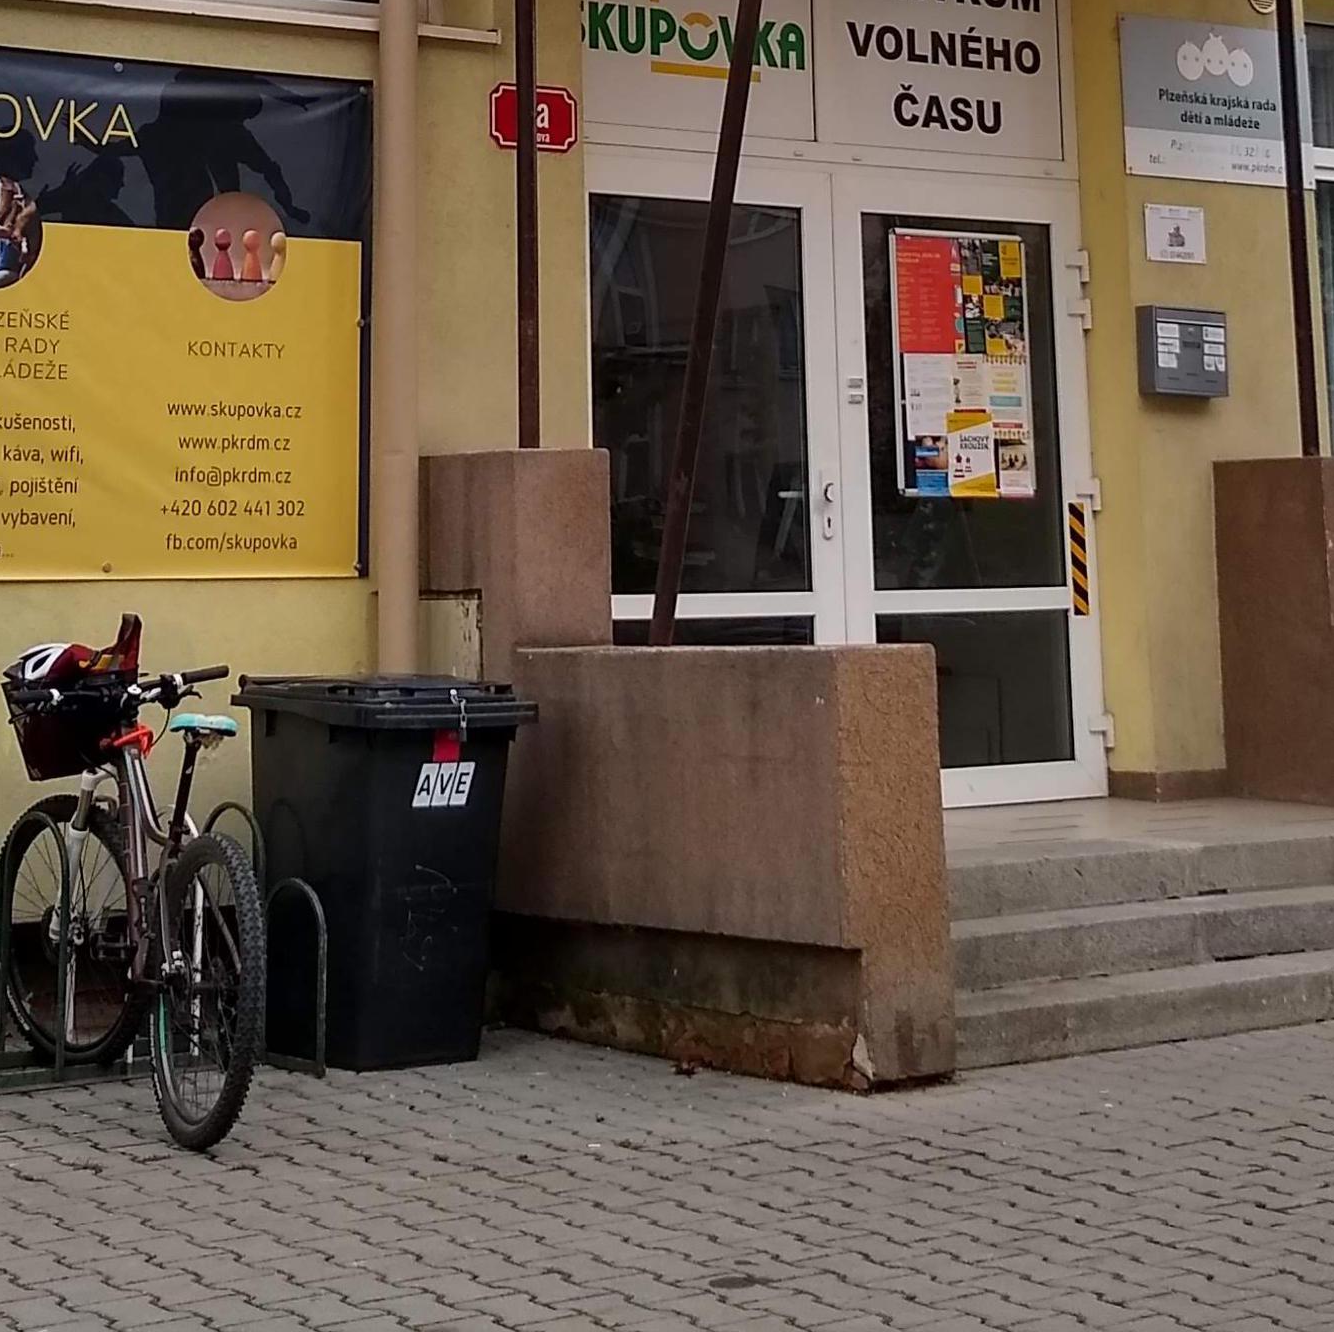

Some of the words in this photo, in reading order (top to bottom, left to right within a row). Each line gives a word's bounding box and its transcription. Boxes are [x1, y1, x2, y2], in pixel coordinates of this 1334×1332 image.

[580, 0, 806, 71] KUPOVKA
[846, 21, 1041, 75] VOLNÉHO
[893, 83, 1002, 135] ČASU
[1210, 93, 1250, 111] krajská
[1252, 98, 1277, 112] rada
[1204, 115, 1212, 125] a
[1214, 114, 1260, 129] mládeže
[1232, 163, 1283, 173] www.pkrdm.c
[5, 337, 60, 354] RADY
[187, 341, 285, 359] KONTAKTY
[167, 401, 302, 421] www.skupovka.cz
[178, 434, 291, 454] www.pkrdm.cz
[3, 445, 45, 465] káva,
[50, 445, 84, 465] wifi,
[175, 466, 292, 487] info@pkrdm.cz
[9, 477, 79, 498] pojištění
[160, 500, 202, 516] +420
[207, 500, 237, 516] 602
[243, 500, 271, 516] 441
[276, 500, 305, 516] 302
[1, 509, 76, 528] vybavení,
[166, 532, 298, 553] fb.com/skupovka
[417, 772, 470, 796] AVE
